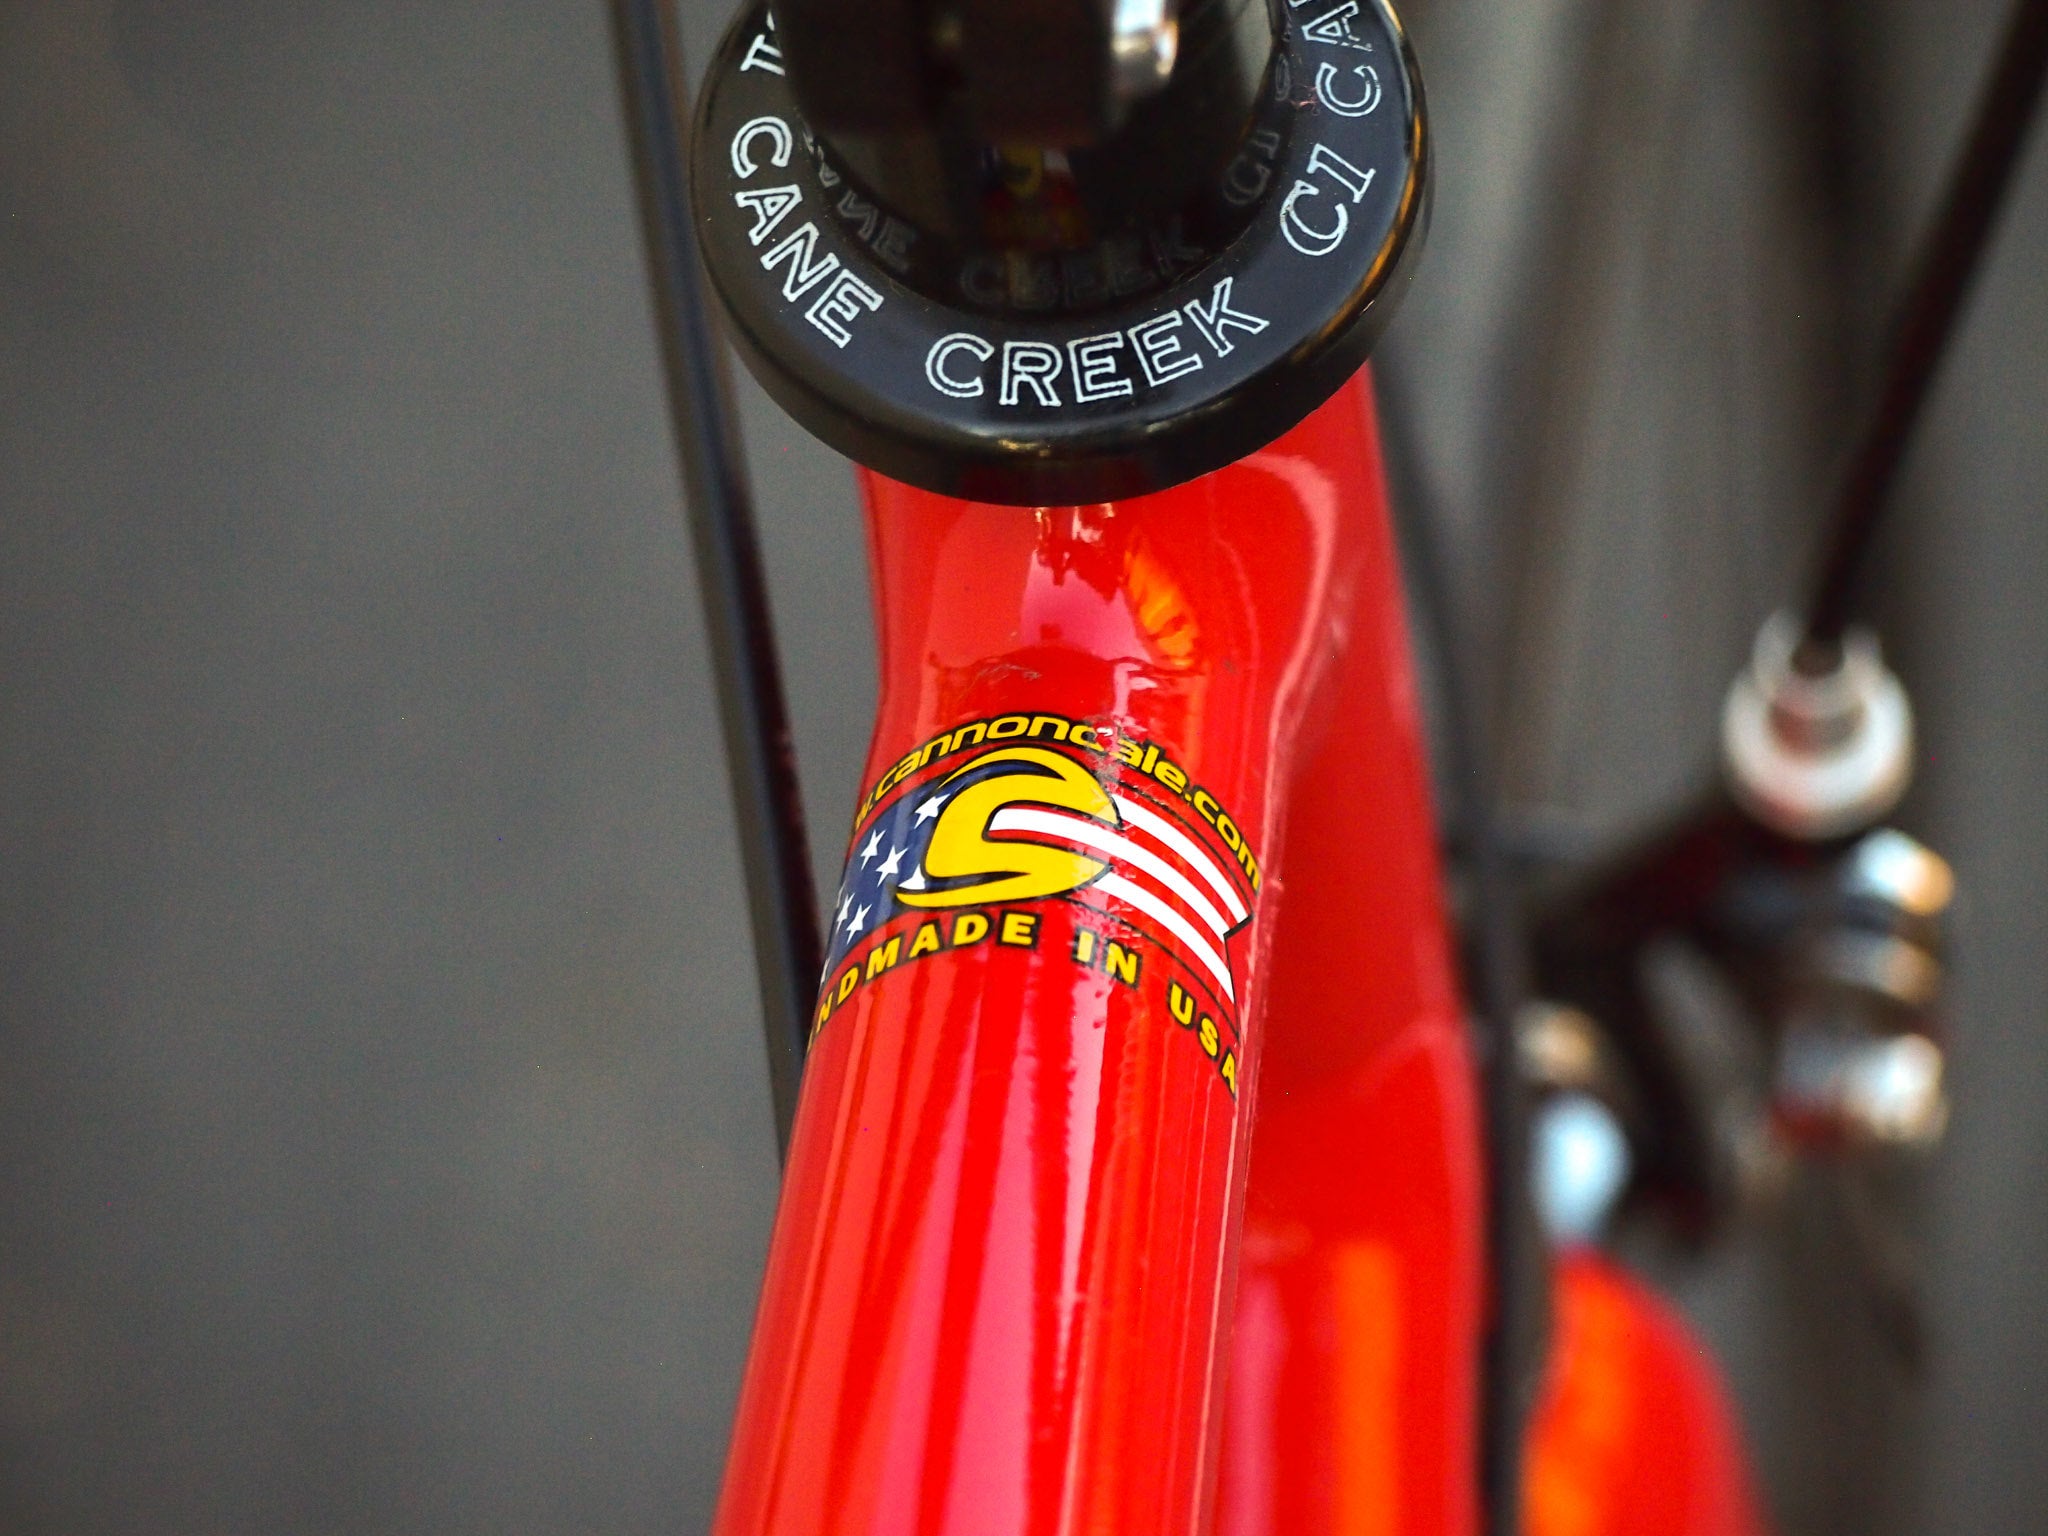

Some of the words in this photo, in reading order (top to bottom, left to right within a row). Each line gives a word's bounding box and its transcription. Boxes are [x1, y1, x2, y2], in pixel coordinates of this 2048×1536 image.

[731, 116, 884, 348] CANE
[925, 276, 1269, 406] CREEK
[1288, 0, 1382, 117] CA
[806, 912, 1037, 1055] NDMADE
[1075, 930, 1138, 985] IN
[1169, 981, 1237, 1097] USA
